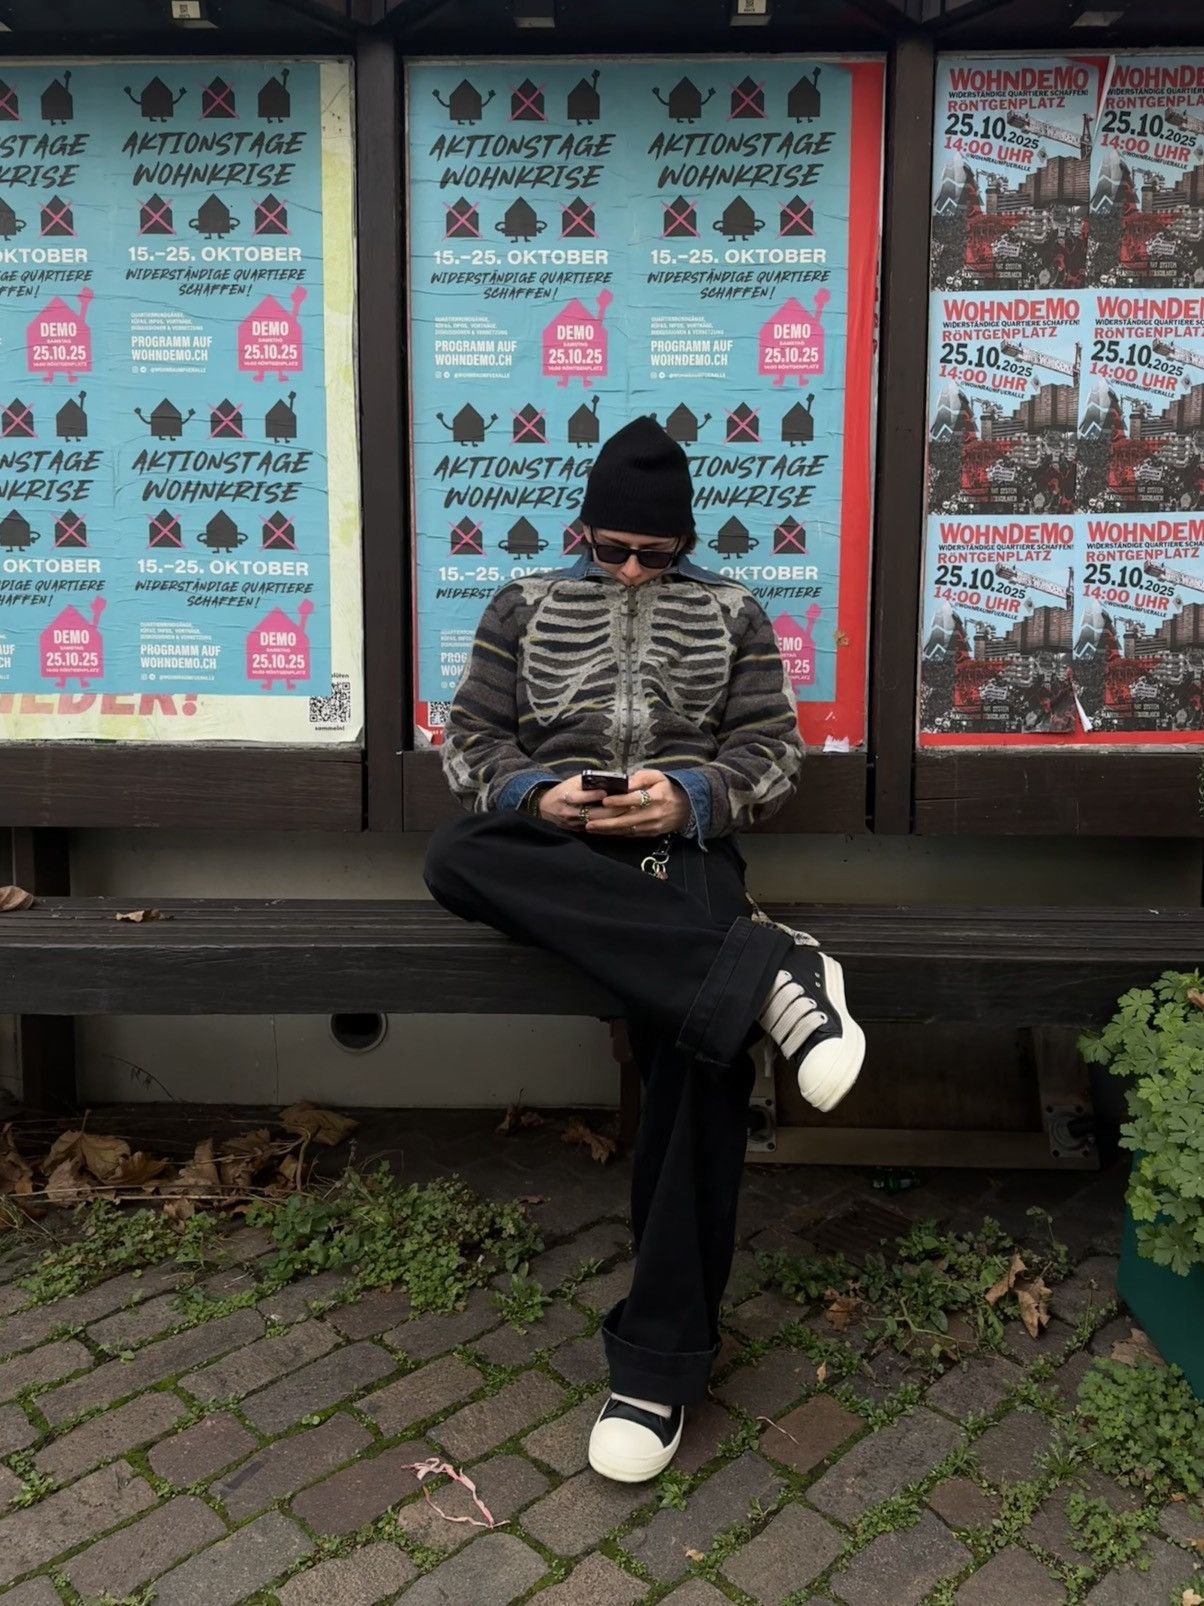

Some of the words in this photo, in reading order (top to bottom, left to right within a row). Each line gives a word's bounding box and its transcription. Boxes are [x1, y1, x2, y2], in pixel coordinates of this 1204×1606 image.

[950, 65, 1089, 91] WOHNDEMO
[0, 133, 91, 159] STAGE
[122, 131, 307, 159] AKTIONSTAGE
[429, 133, 616, 161] AKTIONSTAGE
[647, 131, 836, 160] AKTIONSTAGE
[944, 136, 993, 156] 14:00
[997, 145, 1034, 164] UHR
[1101, 133, 1150, 153] 14:00
[1154, 142, 1191, 162] UHR
[0, 164, 80, 189] KRISE
[132, 161, 296, 188] WOHNKRISE
[439, 164, 604, 190] WOHNKRISE
[657, 163, 824, 190] WOHNKRISE
[0, 247, 88, 263] KTOBER
[201, 246, 303, 262] OKTOBER
[507, 250, 609, 265] OKTOBER
[725, 249, 826, 264] OKTOBER
[20, 269, 93, 283] QUARTIERE
[125, 266, 231, 282] WIDERSTÄNDIGE
[233, 268, 307, 282] QUARTIERE
[431, 270, 536, 284] WIDERSTÄNDIGE
[539, 272, 613, 284] QUARTIERE
[647, 269, 754, 284] WIDERSTÄNDIGE
[757, 270, 831, 284] QUARTIERE
[0, 285, 40, 299] FFEN!
[178, 283, 253, 297] SCHAFFEN!
[483, 287, 558, 300] SCHAFFEN!
[700, 286, 775, 299] SCHAFFEN!
[943, 297, 1080, 321] WOHNDEMO
[1097, 296, 1204, 320] WOHNDE
[40, 322, 77, 337] DEMO
[252, 321, 289, 336] DEMO
[557, 325, 594, 340] DEMO
[774, 323, 811, 339] DEMO
[131, 336, 190, 348] PROGRAMM
[193, 336, 213, 348] AUF
[435, 340, 495, 352] PROGRAMM
[497, 340, 517, 352] AUF
[651, 340, 711, 352] PROGRAMM
[712, 340, 734, 351] AUF
[33, 345, 86, 361] 25.10.25
[131, 349, 208, 361] WOHNDEMO.CH
[244, 344, 297, 360] 25.10.25
[435, 354, 512, 366] WOHNDEMO.CH
[549, 349, 602, 364] 25.10.25
[651, 354, 728, 366] WOHNDEMO.CH
[765, 347, 818, 363] 25.10.25
[939, 365, 987, 384] 14:00
[992, 373, 1028, 391] UHR
[1090, 362, 1138, 382] 14:00
[1142, 372, 1178, 391] UHR
[0, 449, 104, 475] NSTAGE
[131, 449, 313, 476] AKTIONSTAGE
[433, 455, 594, 482] AKTIONSTAG
[686, 454, 829, 480] IONSTAGE
[0, 478, 94, 502] KRISE
[142, 478, 302, 503] WOHNKRISE
[444, 485, 585, 510] WOHNKRIS
[693, 485, 816, 509] HNKRISE
[940, 522, 1074, 544] WOHNDEMO
[1087, 520, 1204, 543] WOHNDEM
[3, 559, 101, 574] OKTOBER
[209, 559, 309, 576] OKTOBER
[34, 579, 106, 592] QUARTIERE
[135, 578, 239, 593] WIDERSTÄNDIGE
[241, 582, 314, 595] QUARTIERE
[436, 587, 495, 599] WIDERST
[0, 594, 54, 607] AFFEN!
[186, 594, 261, 608] SCHAFFEN!
[934, 586, 981, 605] 14:00
[985, 595, 1021, 613] UHR
[1083, 584, 1130, 602] 14:00
[1134, 593, 1169, 611] UHR
[53, 630, 89, 645] DEMO
[260, 632, 296, 647] DEMO
[778, 637, 802, 651] EMO
[0, 644, 15, 655] UF
[140, 644, 200, 656] PROGRAMM
[201, 645, 221, 657] AUF
[441, 652, 468, 663] PROG
[46, 652, 98, 666] 25.10.25
[140, 657, 216, 669] WOHNDEMO.CH
[252, 654, 305, 669] 25.10.25
